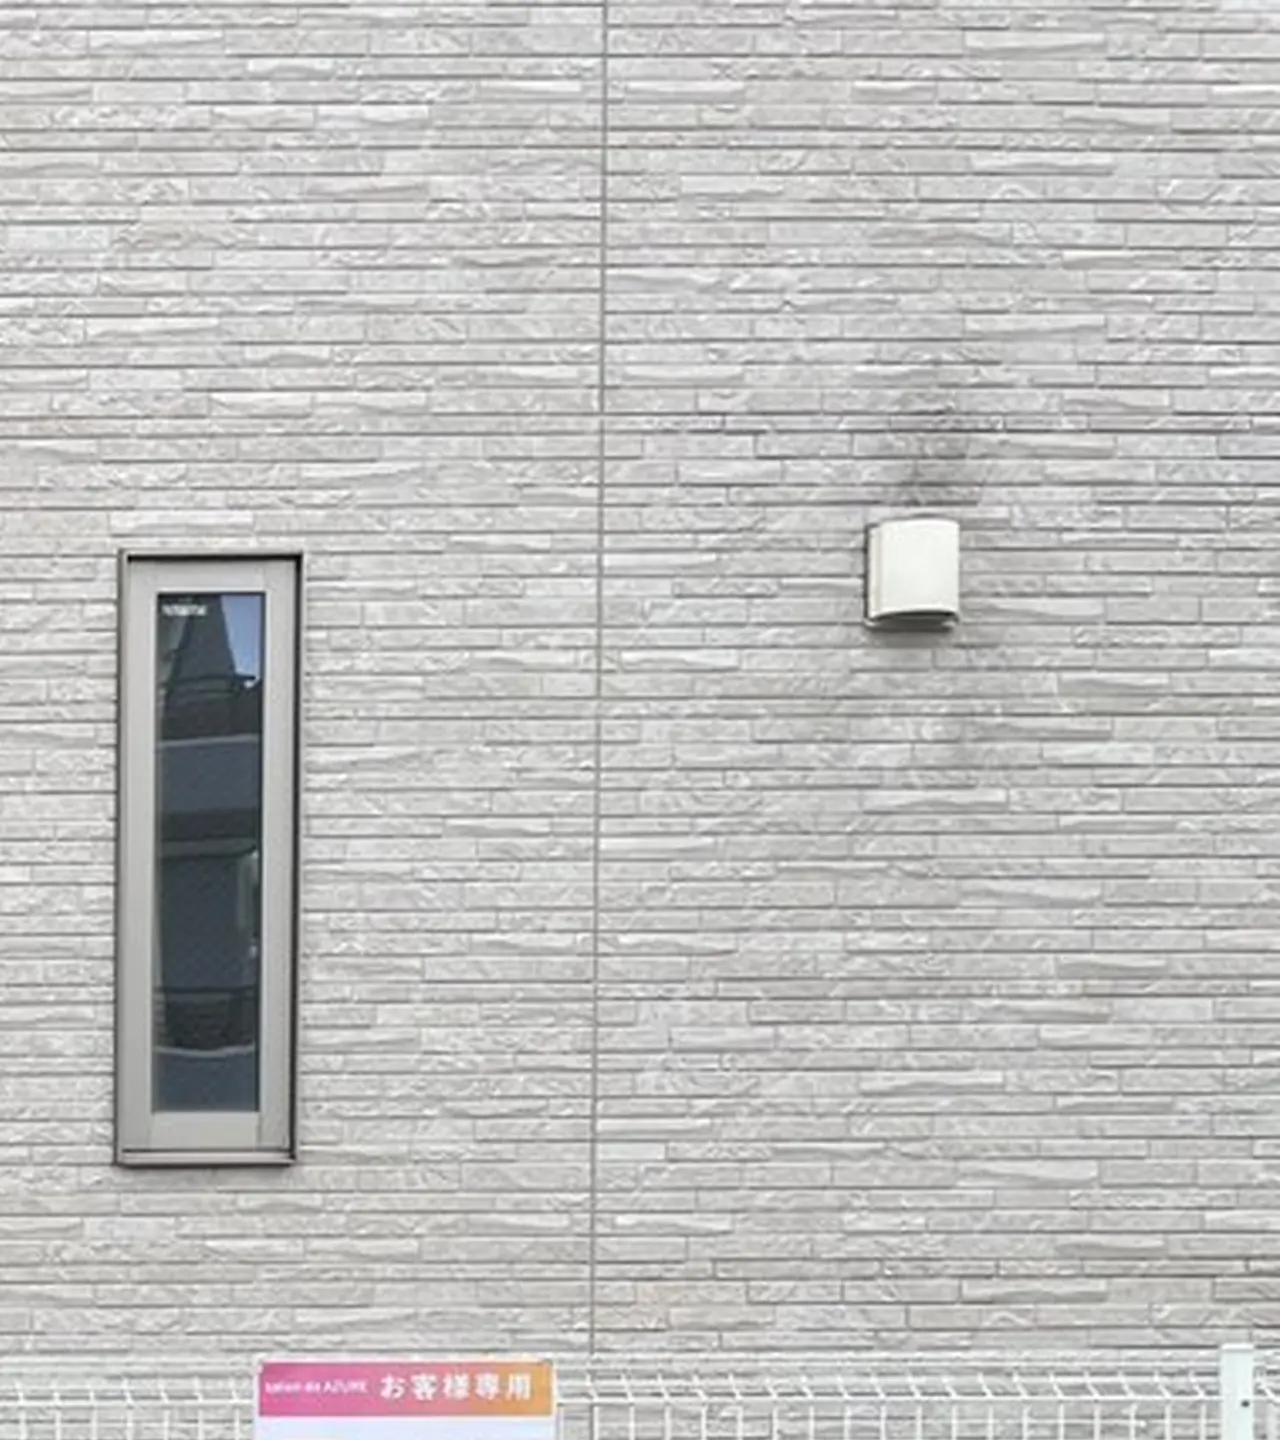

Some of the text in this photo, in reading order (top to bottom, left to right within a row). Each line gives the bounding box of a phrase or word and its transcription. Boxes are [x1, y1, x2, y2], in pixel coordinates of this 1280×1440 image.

[379, 1373, 532, 1401] お客様専用
